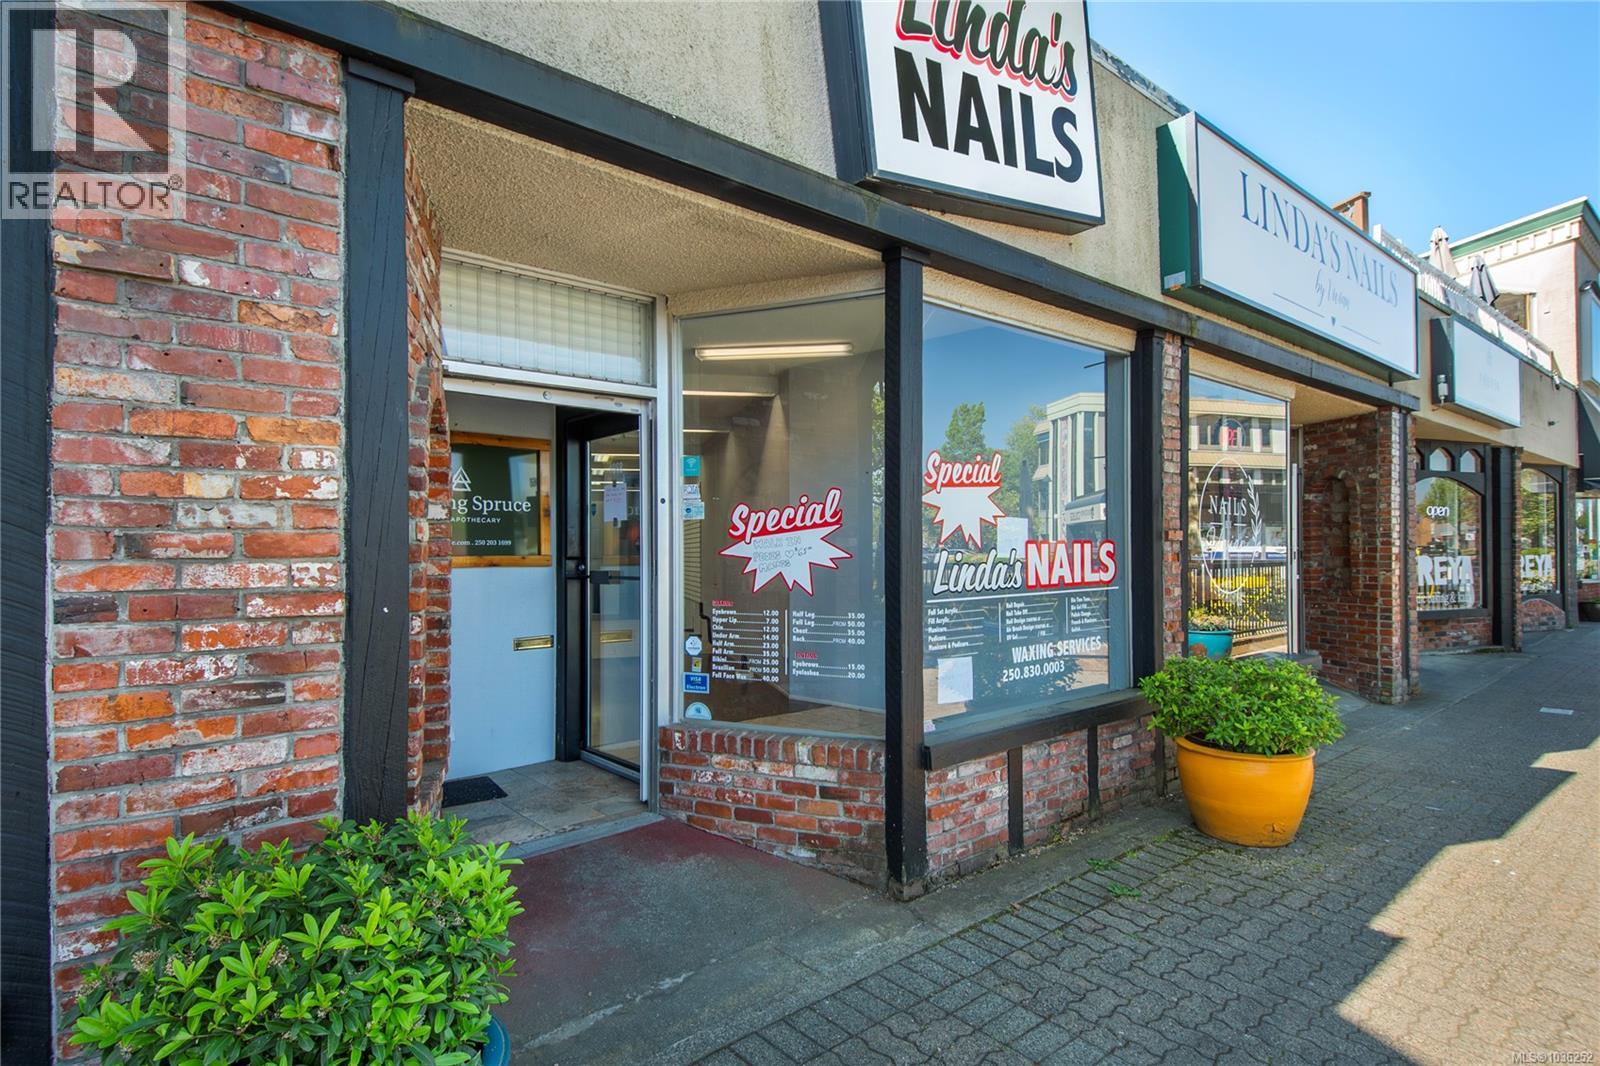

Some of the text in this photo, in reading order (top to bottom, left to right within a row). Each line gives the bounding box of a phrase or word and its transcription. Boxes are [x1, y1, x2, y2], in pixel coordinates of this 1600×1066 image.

[893, 46, 1083, 183] NAILS
[1239, 170, 1399, 308] LINDA'S NAILS
[924, 451, 1002, 493] Special
[472, 495, 532, 515] Spruce
[728, 487, 842, 544] Special
[1208, 495, 1247, 516] NAILS
[932, 540, 1117, 595] Linda's NAILS
[1002, 660, 1065, 682] 250.830.0003
[1012, 636, 1102, 664] WAXING SERVICES
